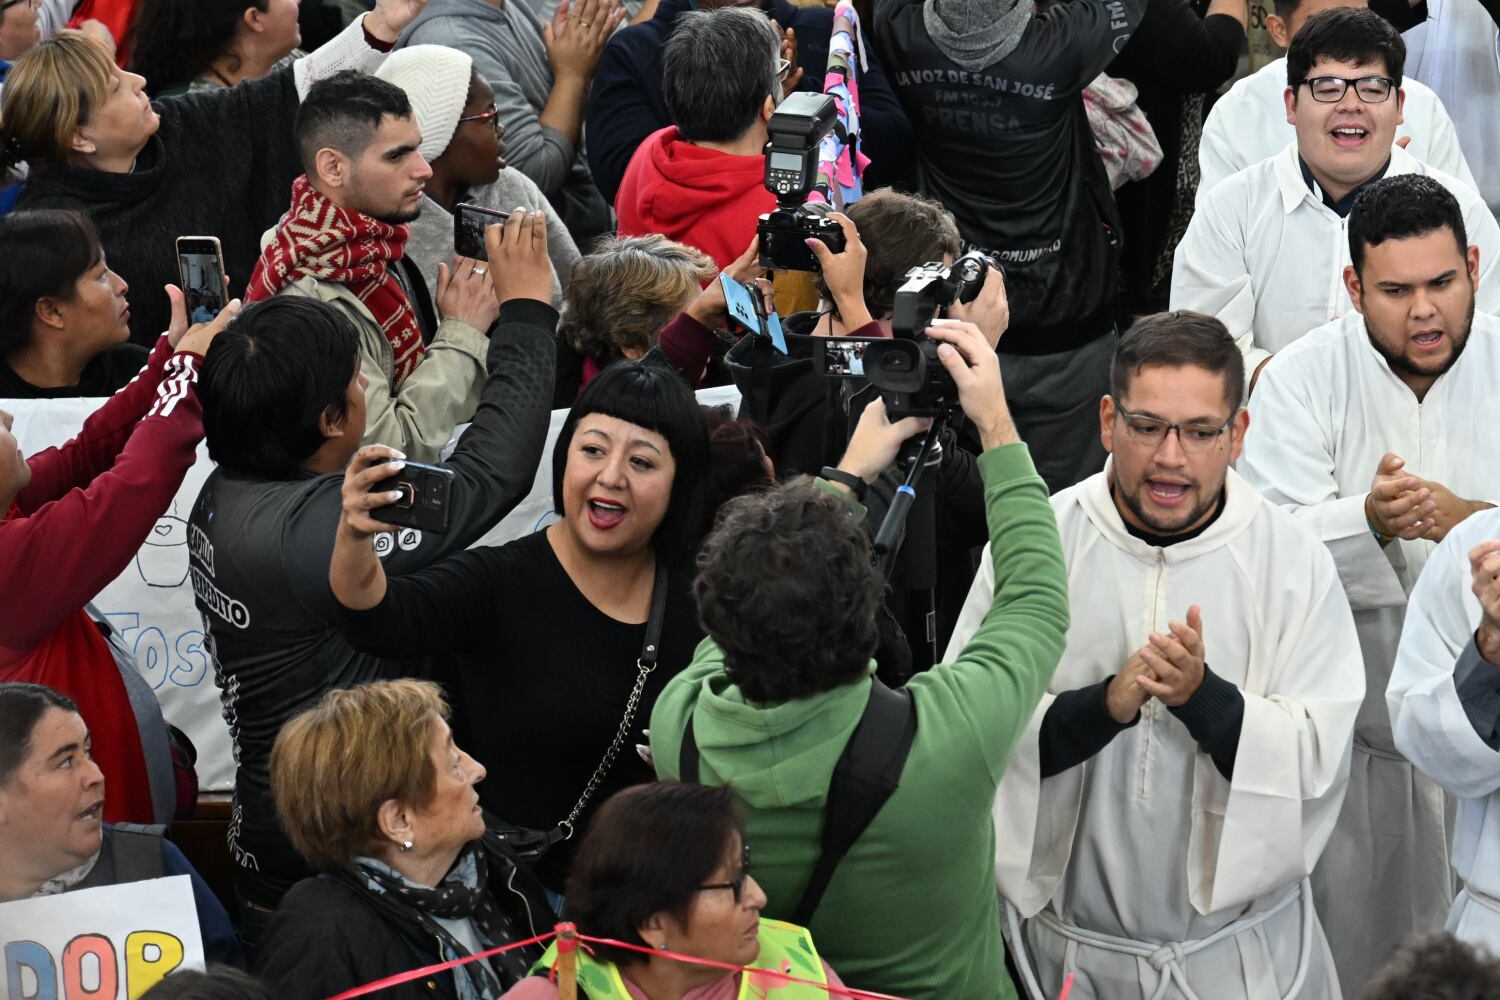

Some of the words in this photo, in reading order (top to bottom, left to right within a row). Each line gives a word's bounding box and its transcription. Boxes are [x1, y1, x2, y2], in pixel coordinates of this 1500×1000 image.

[895, 71, 911, 86] LA
[911, 69, 946, 84] VOZ
[947, 70, 969, 85] DE
[971, 73, 1008, 91] SAN
[1010, 81, 1056, 101] JOSÉ
[935, 89, 958, 103] FM
[923, 106, 1025, 134] PRENSA
